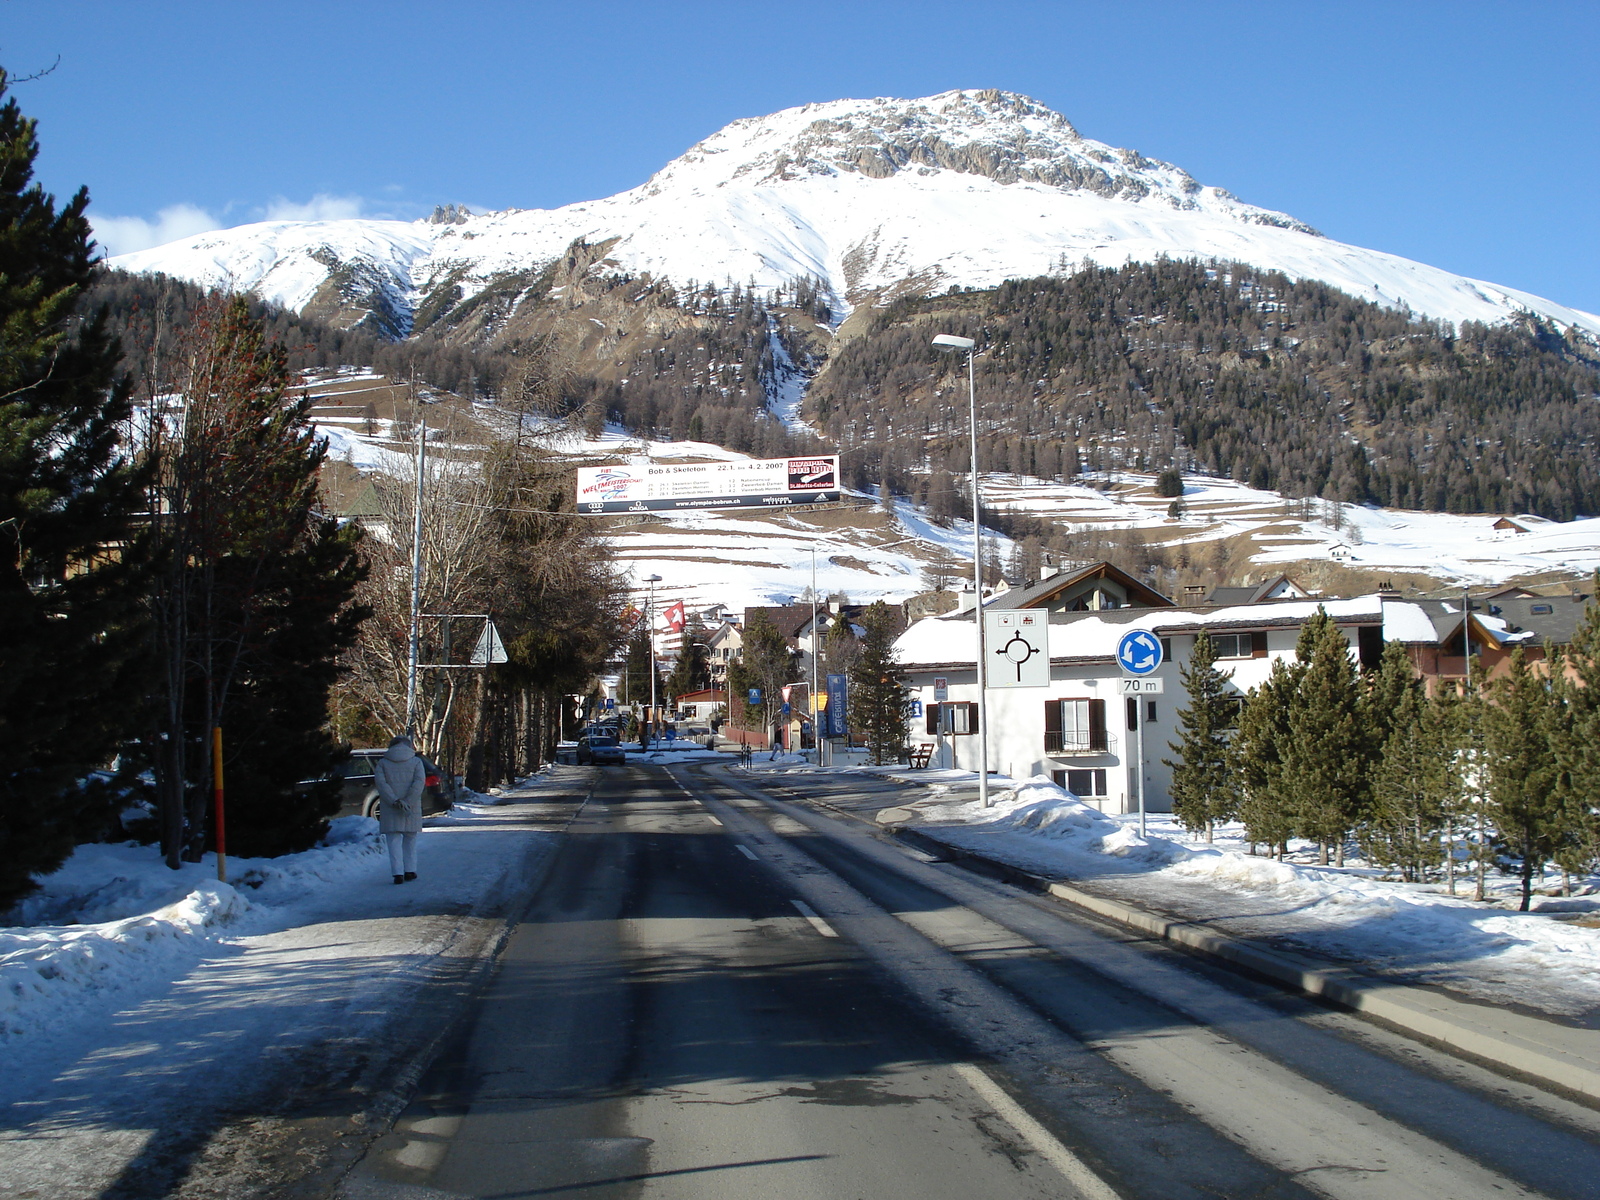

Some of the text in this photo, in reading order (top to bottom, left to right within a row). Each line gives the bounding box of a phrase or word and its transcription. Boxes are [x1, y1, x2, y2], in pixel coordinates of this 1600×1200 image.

[673, 466, 706, 474] Skeleton
[765, 462, 784, 470] 2007
[788, 465, 834, 475] BOB RUN
[1124, 679, 1156, 691] 70 m
